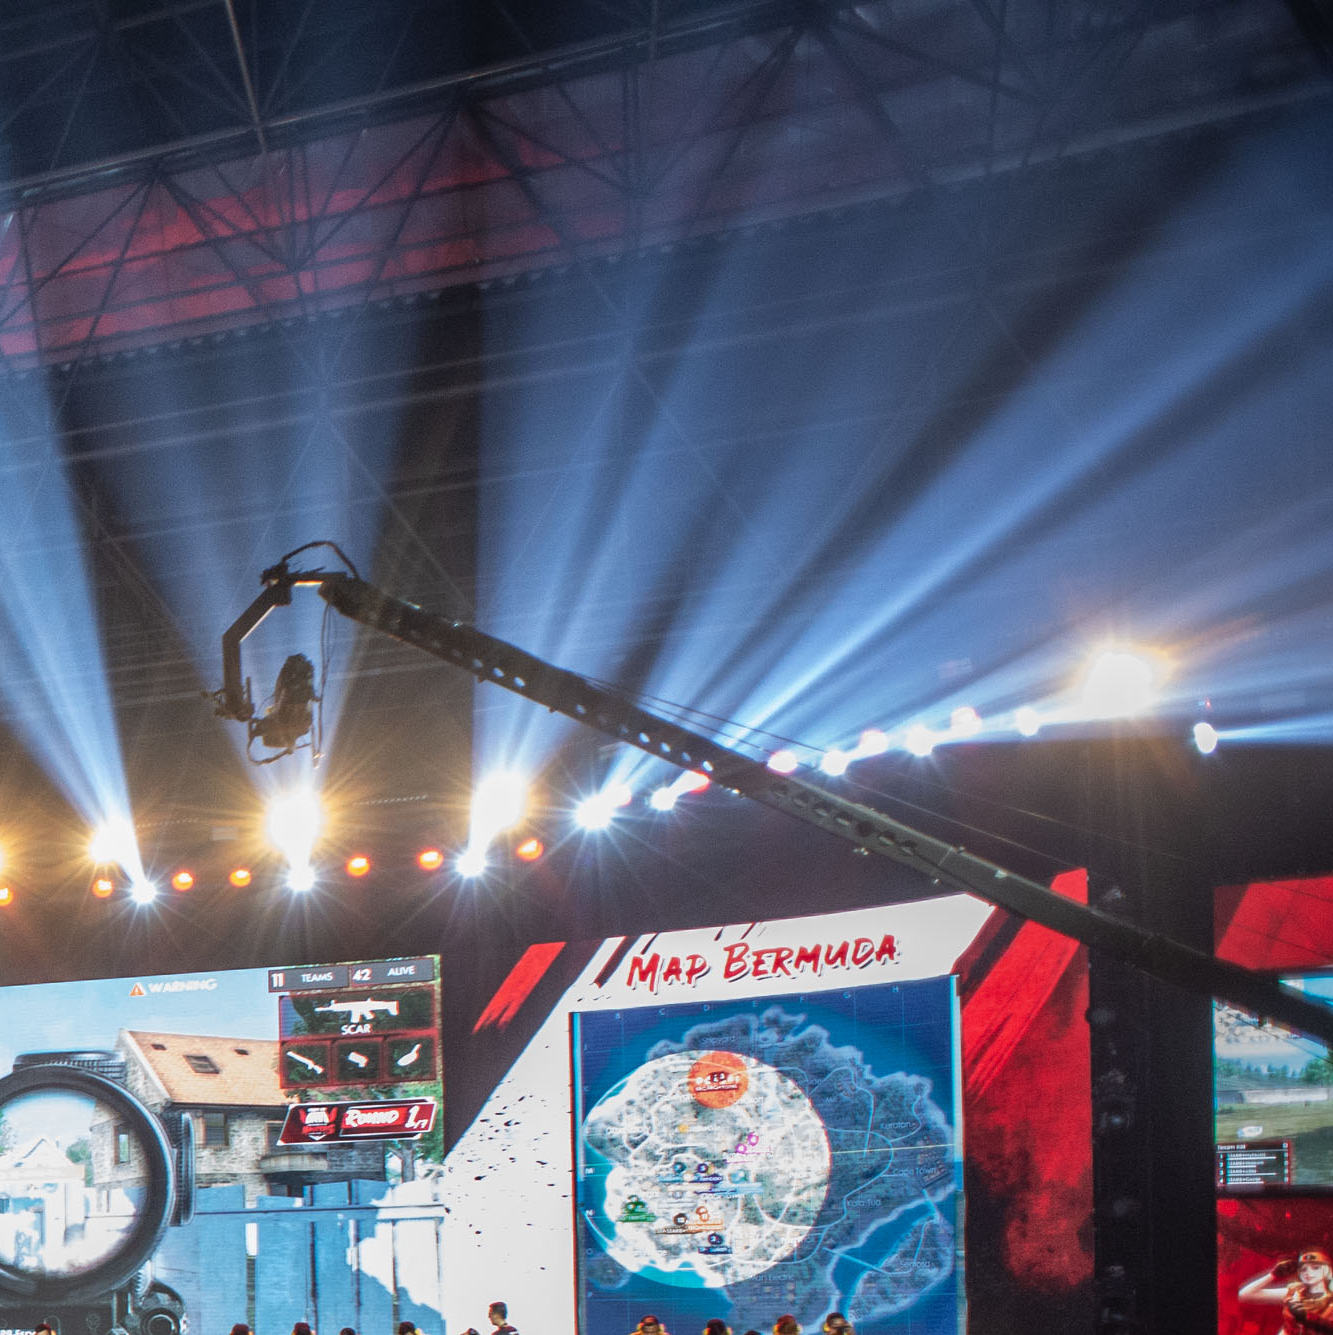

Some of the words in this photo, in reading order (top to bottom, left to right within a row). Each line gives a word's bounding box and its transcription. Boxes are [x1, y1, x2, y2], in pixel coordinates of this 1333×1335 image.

[627, 951, 710, 993] MAP
[723, 934, 898, 984] BERMUDA
[271, 973, 284, 987] 11
[301, 972, 333, 983] TEAMS
[353, 968, 372, 981] 42
[387, 965, 416, 976] ALIVE
[341, 1024, 372, 1036] SCAR
